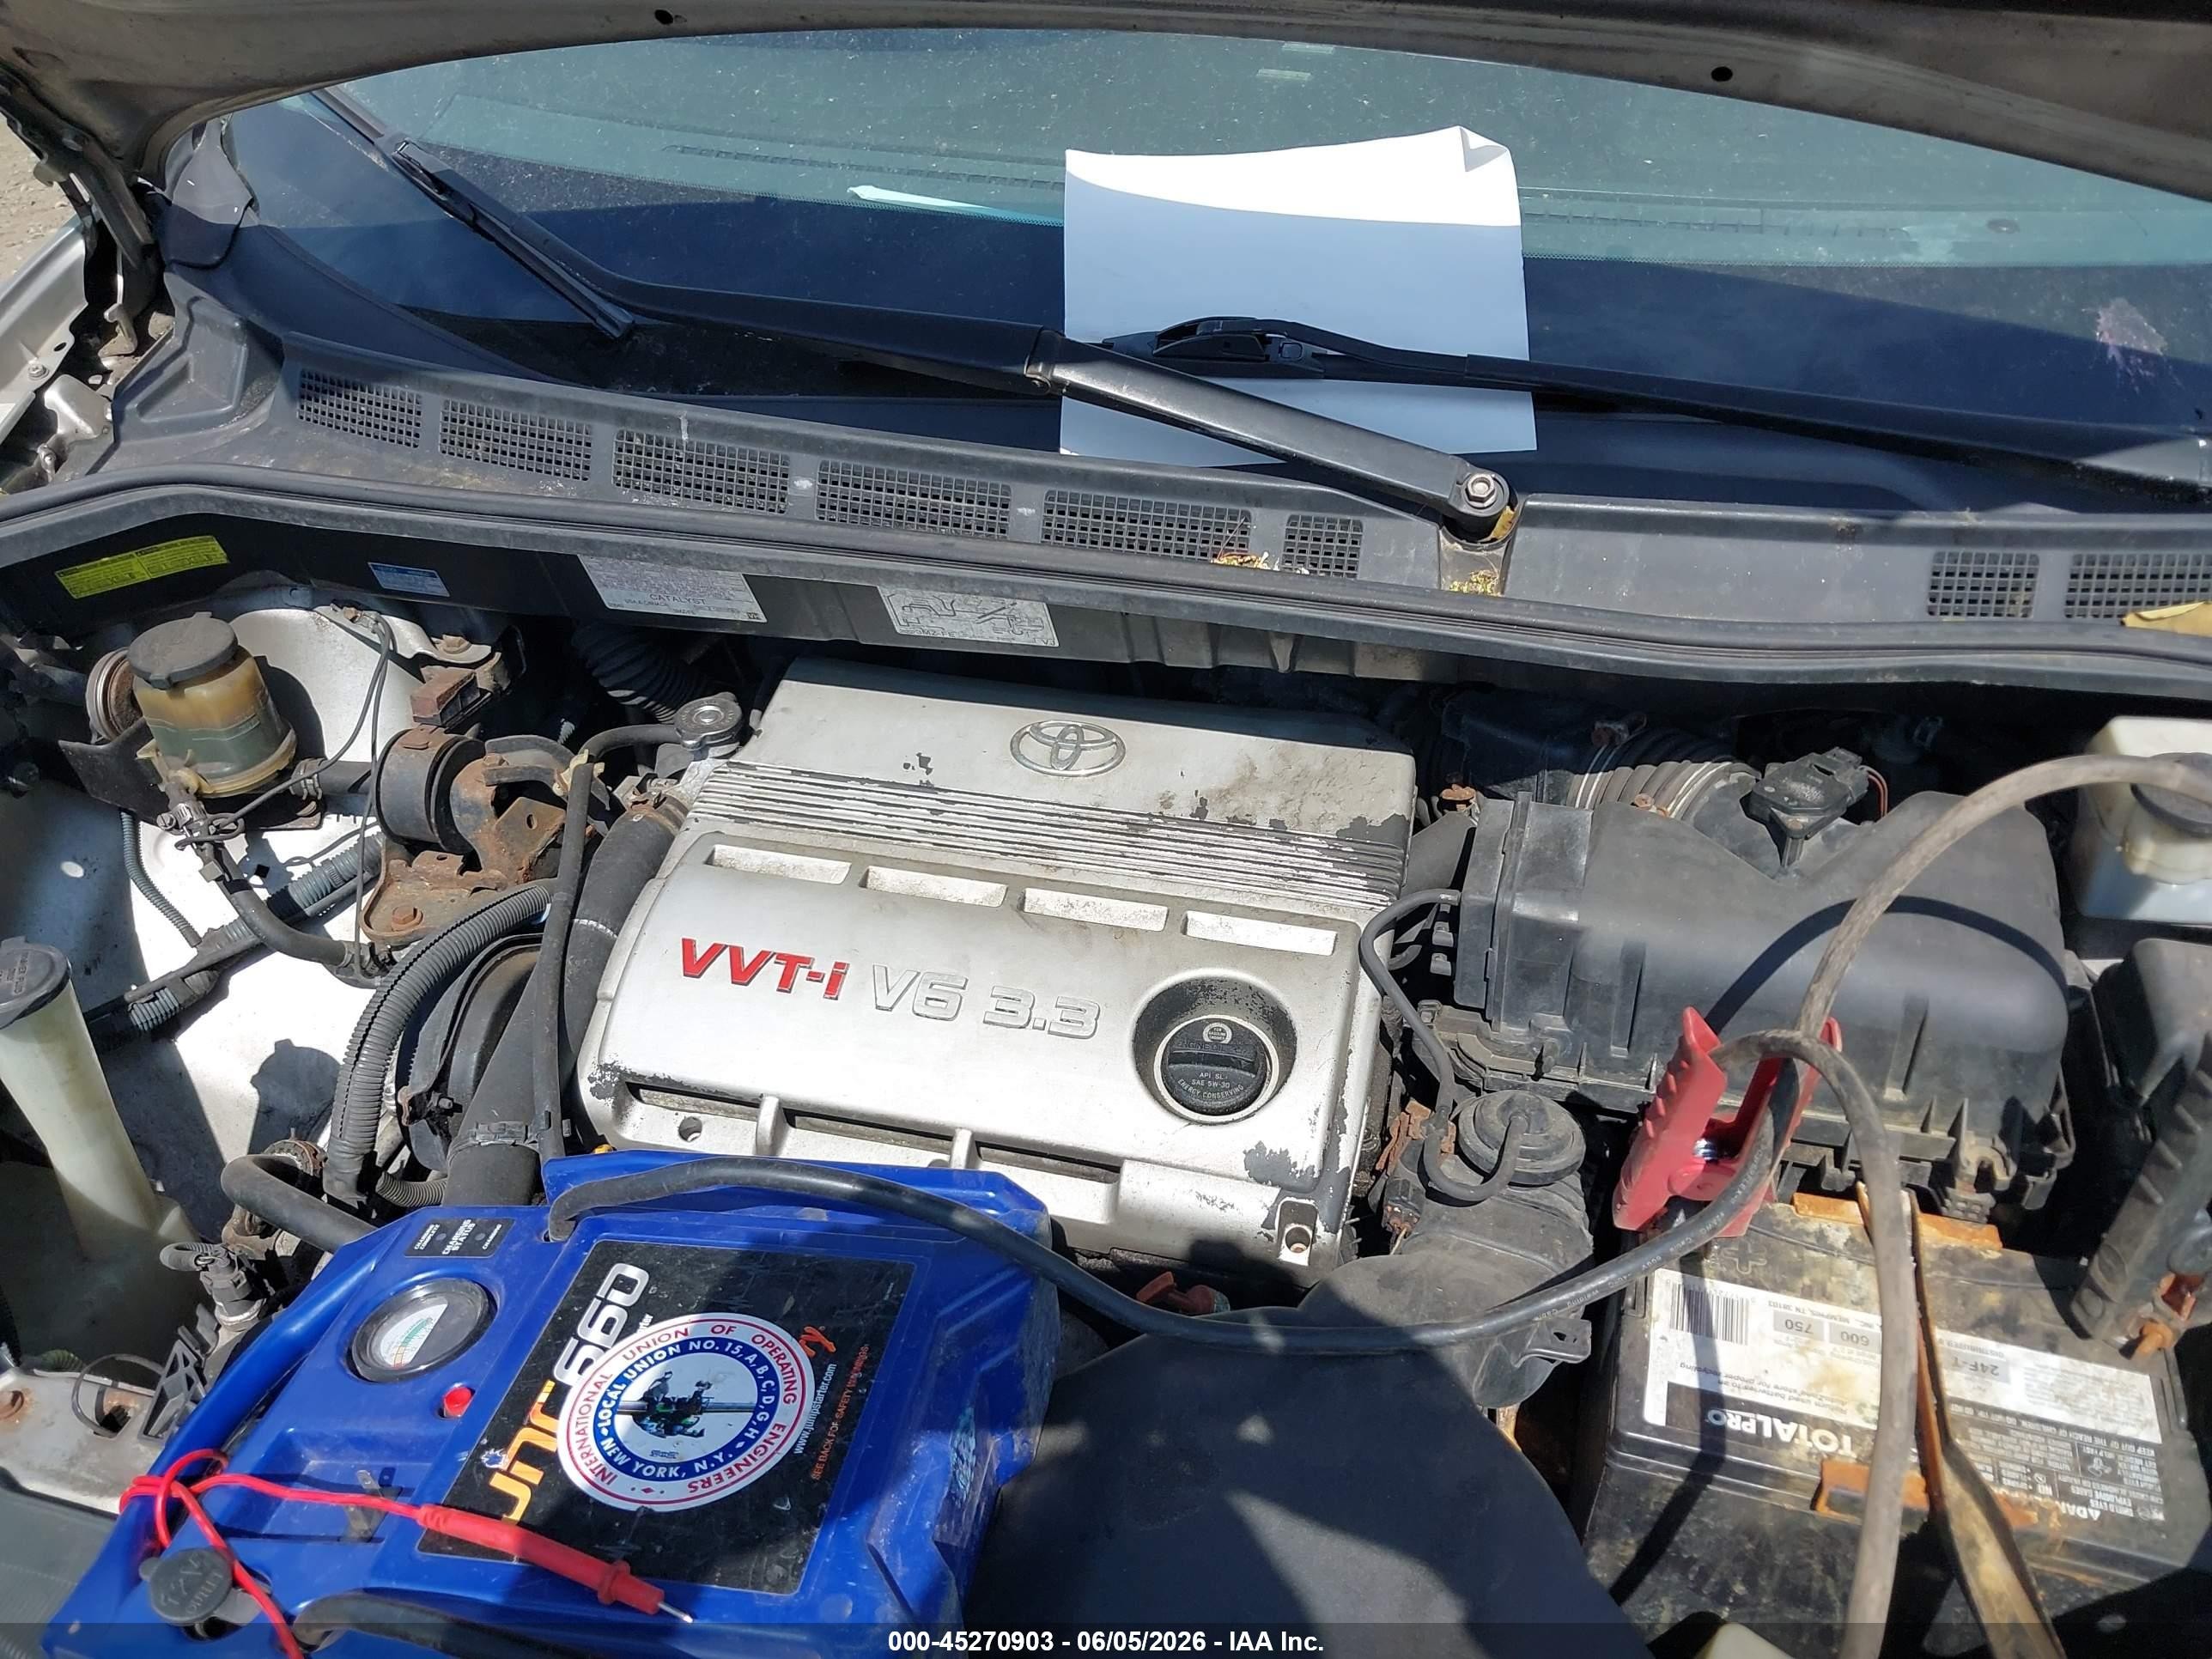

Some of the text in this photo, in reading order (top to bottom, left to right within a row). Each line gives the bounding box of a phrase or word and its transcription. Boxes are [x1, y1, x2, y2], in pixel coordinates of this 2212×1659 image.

[649, 593, 707, 605] CATALYST
[681, 937, 1102, 1040] VVT-i V6 3.3
[1177, 1079, 1244, 1099] ENERGY CONSERVING
[441, 1219, 471, 1255] CHARGING
[452, 1223, 476, 1251] STATUS
[709, 1323, 738, 1335] OF
[1784, 1319, 1815, 1334] 750
[1839, 1331, 1870, 1346] 600
[623, 1328, 690, 1362] UNION
[598, 1382, 627, 1428] LOCAL
[623, 1344, 682, 1382] UNION
[689, 1340, 720, 1352] NO.
[750, 1334, 799, 1406] OPERATING
[793, 1363, 838, 1455] www.jumpstarter.com
[574, 1371, 618, 1486] INTERNATIONAL
[810, 1461, 825, 1480] SEE
[819, 1437, 835, 1462] BACK
[835, 1389, 853, 1421] SAFETY
[1706, 1407, 1862, 1458] TOTALPRO
[2068, 1431, 2094, 1443] REACH
[2092, 1436, 2108, 1446] THE
[601, 1438, 632, 1467] NEW
[632, 1460, 687, 1479] YORK,
[687, 1422, 788, 1494] ENGINEERS
[2136, 1446, 2156, 1457] KEEP
